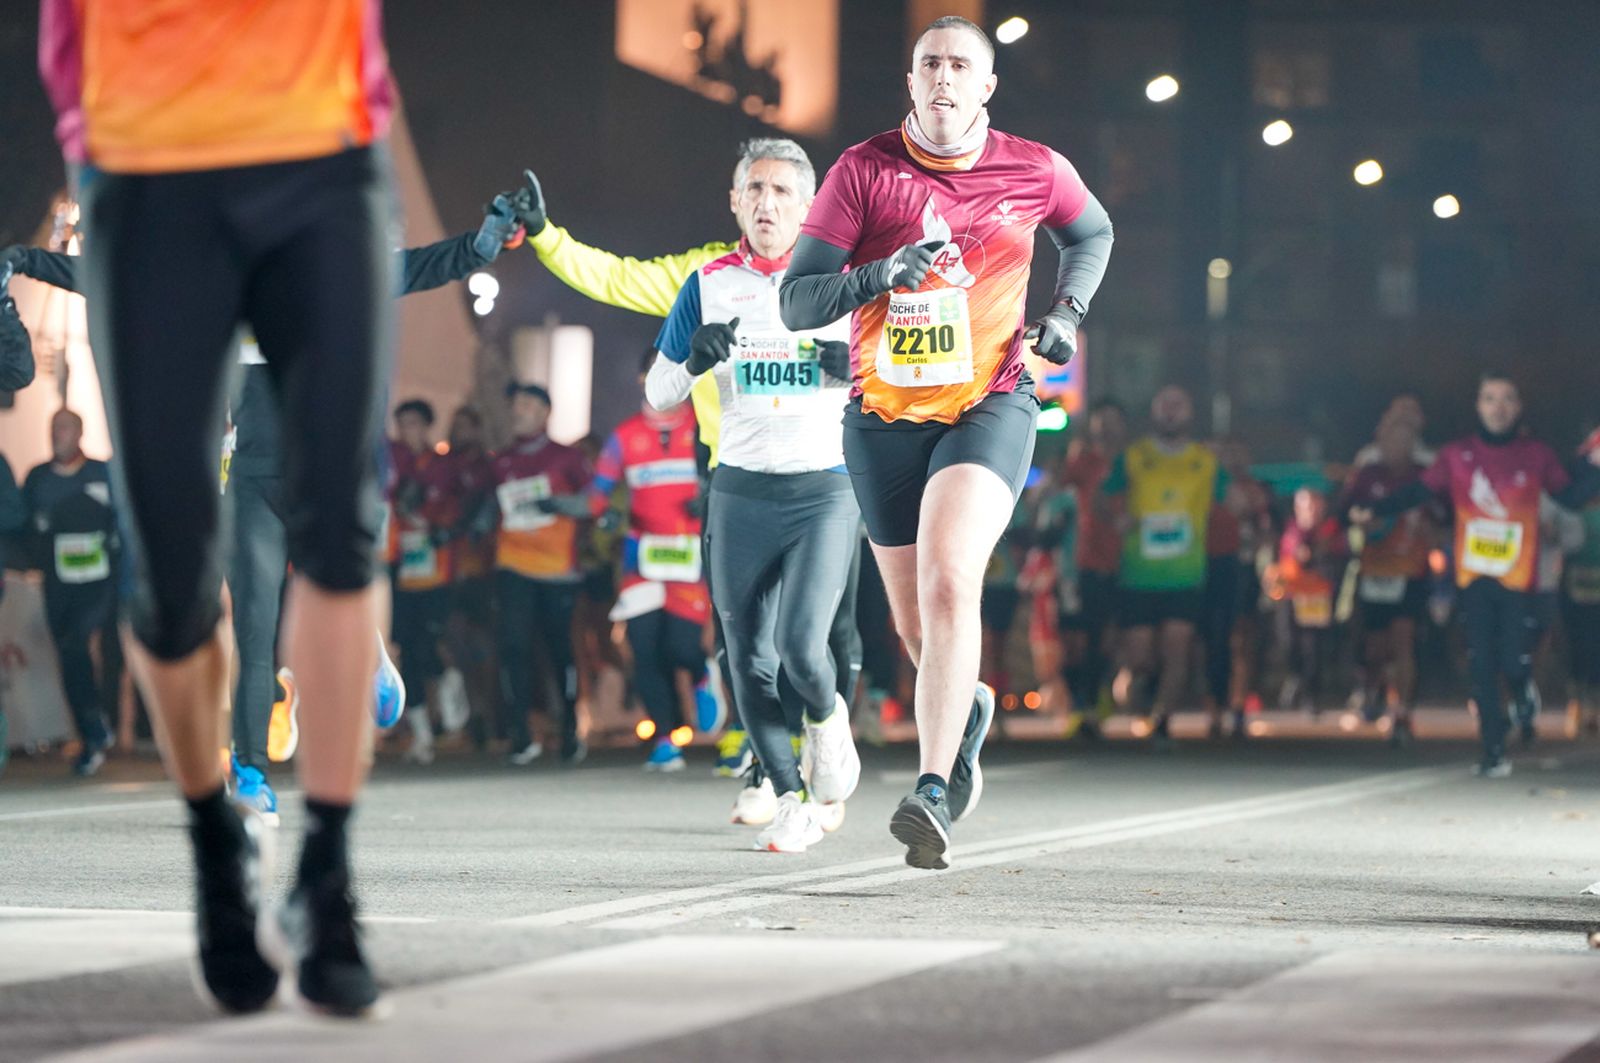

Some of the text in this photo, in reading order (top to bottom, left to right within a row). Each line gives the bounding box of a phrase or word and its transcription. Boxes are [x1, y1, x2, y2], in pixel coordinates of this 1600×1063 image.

[918, 303, 930, 313] DE
[886, 324, 955, 355] 12210
[751, 340, 776, 350] NOCHE
[778, 341, 789, 350] DE
[740, 351, 758, 360] SAN
[741, 362, 813, 387] 14045
